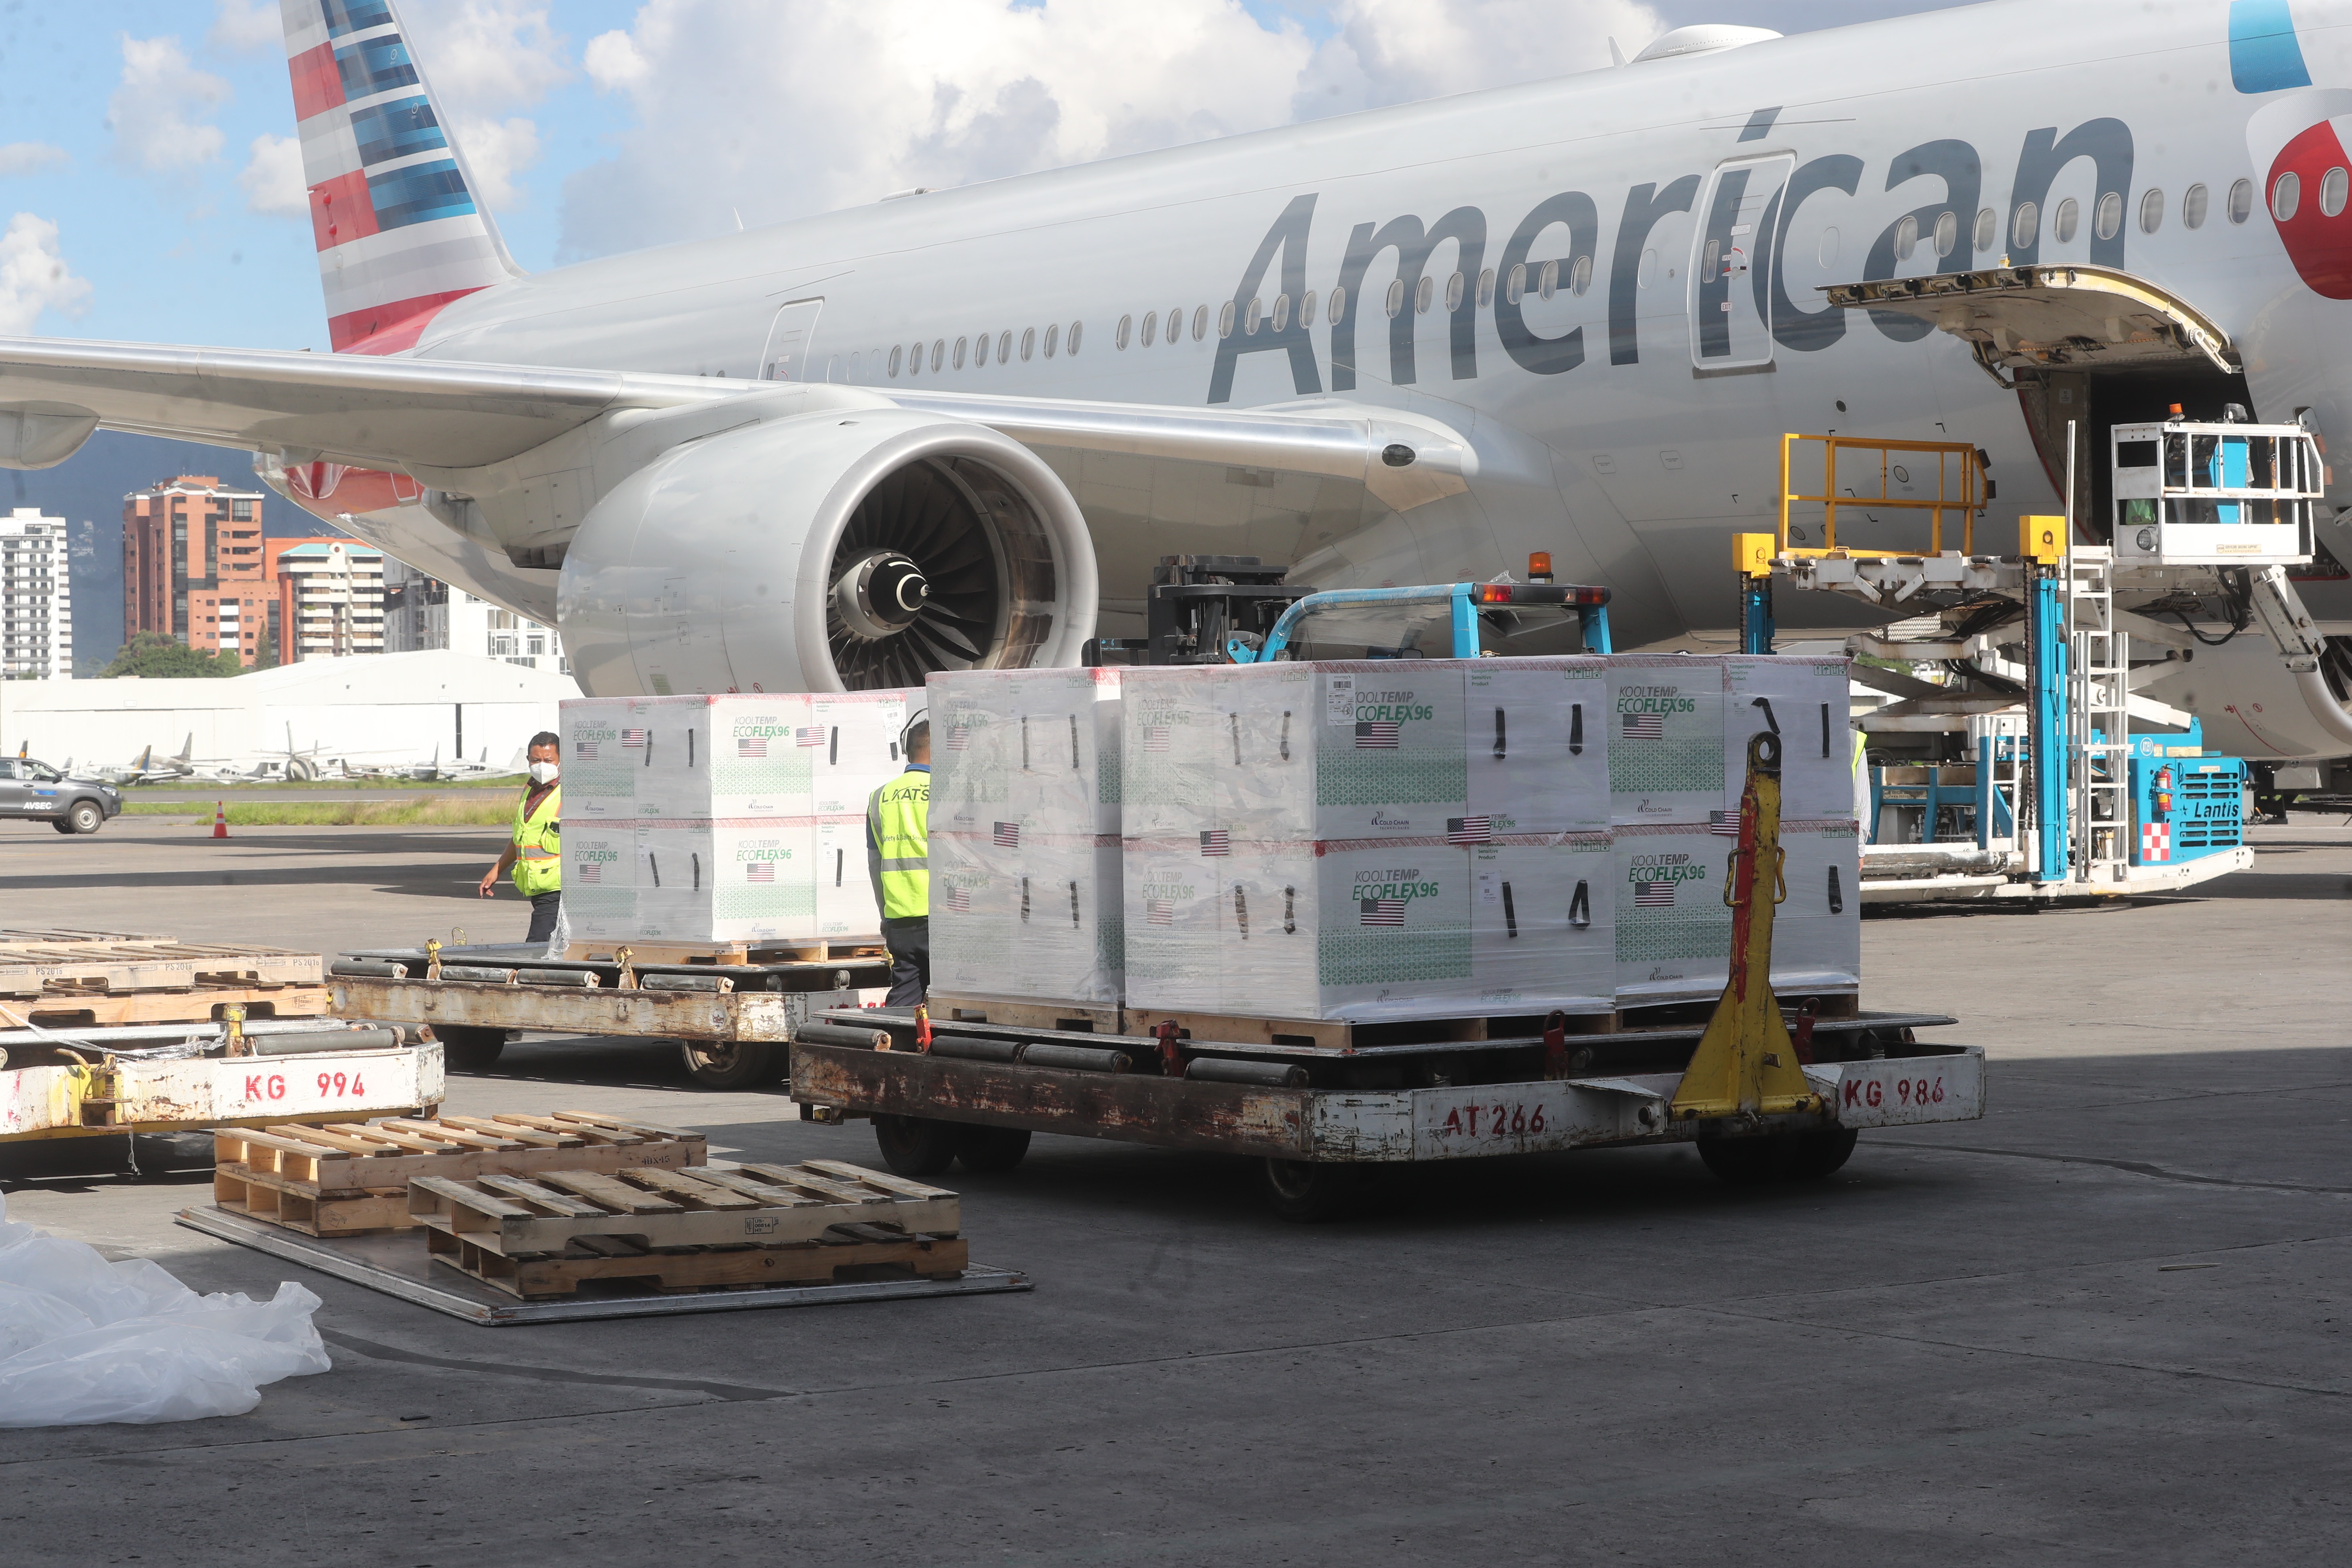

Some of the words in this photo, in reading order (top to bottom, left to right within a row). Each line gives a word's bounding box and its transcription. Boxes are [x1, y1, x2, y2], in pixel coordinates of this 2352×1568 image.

[1207, 106, 2135, 404] American
[1619, 686, 1678, 697] KOOLTEMP
[1356, 699, 1433, 727] COFLEX96
[1617, 693, 1695, 719] ECOFLEX96
[575, 720, 606, 729] KOOLTEMP
[735, 717, 777, 725] KOOLTEMP
[573, 728, 616, 744] ECOFLEX96
[733, 723, 790, 741] ECOFLEX96
[638, 807, 659, 815] ECOFLEX96
[818, 804, 845, 812] ECOFLEX96
[2195, 801, 2239, 818] Lantis
[1489, 819, 1516, 831] FLEX96
[738, 839, 780, 848] KOOLTEMP
[575, 849, 618, 866] ECOFLEX96
[736, 846, 792, 864] ECOFLEX96
[1631, 854, 1689, 866] KOOLTEMP
[1143, 871, 1182, 882] KOOLTEMP
[1355, 869, 1419, 882] KOOLTEMP
[1628, 860, 1706, 887] ECOFLEX96
[1142, 880, 1194, 904] ECOFLEX96
[1352, 877, 1439, 905] ECOFLEX96
[822, 925, 849, 934] ECOFLEX96
[1480, 993, 1521, 1004] ECOFLEX96
[245, 1075, 285, 1101] KG
[318, 1072, 364, 1097] 994
[1844, 1079, 1882, 1109] KG
[1898, 1077, 1944, 1106] 986
[1447, 1106, 1480, 1137] AT
[1492, 1104, 1545, 1134] 266
